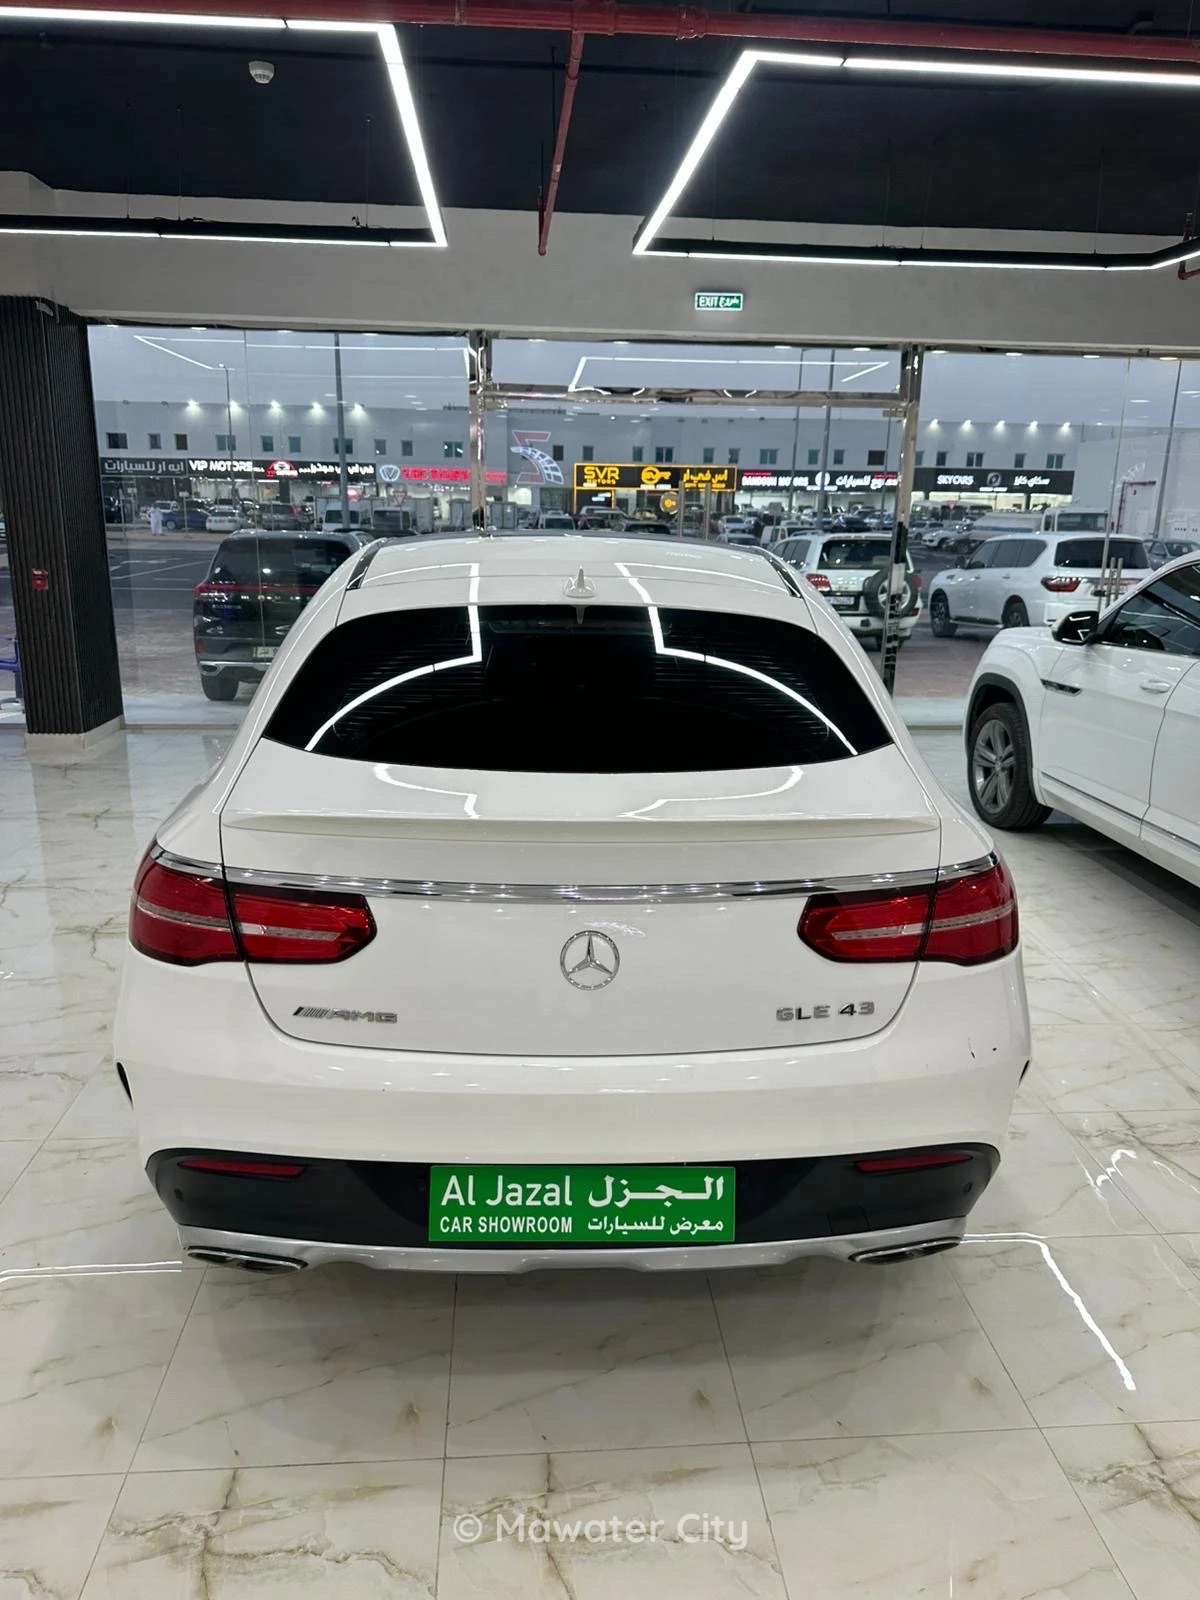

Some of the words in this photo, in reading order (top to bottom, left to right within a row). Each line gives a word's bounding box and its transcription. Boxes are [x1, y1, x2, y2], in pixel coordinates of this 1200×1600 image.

[699, 296, 719, 307] EXIT
[104, 460, 155, 473] للسيارات
[188, 460, 208, 471] VIP
[583, 466, 620, 480] SVR
[401, 467, 471, 481] VICTORY
[327, 1009, 398, 1024] AMG
[776, 1005, 831, 1021] GLE
[838, 1001, 875, 1016] 43
[441, 1175, 476, 1206] Al
[486, 1175, 573, 1206] Jazal
[588, 1175, 724, 1208] الجزل
[440, 1216, 472, 1233] CAR
[478, 1216, 573, 1233] SHOWROOM
[588, 1215, 666, 1235] للسيارات
[670, 1217, 724, 1235] معرض
